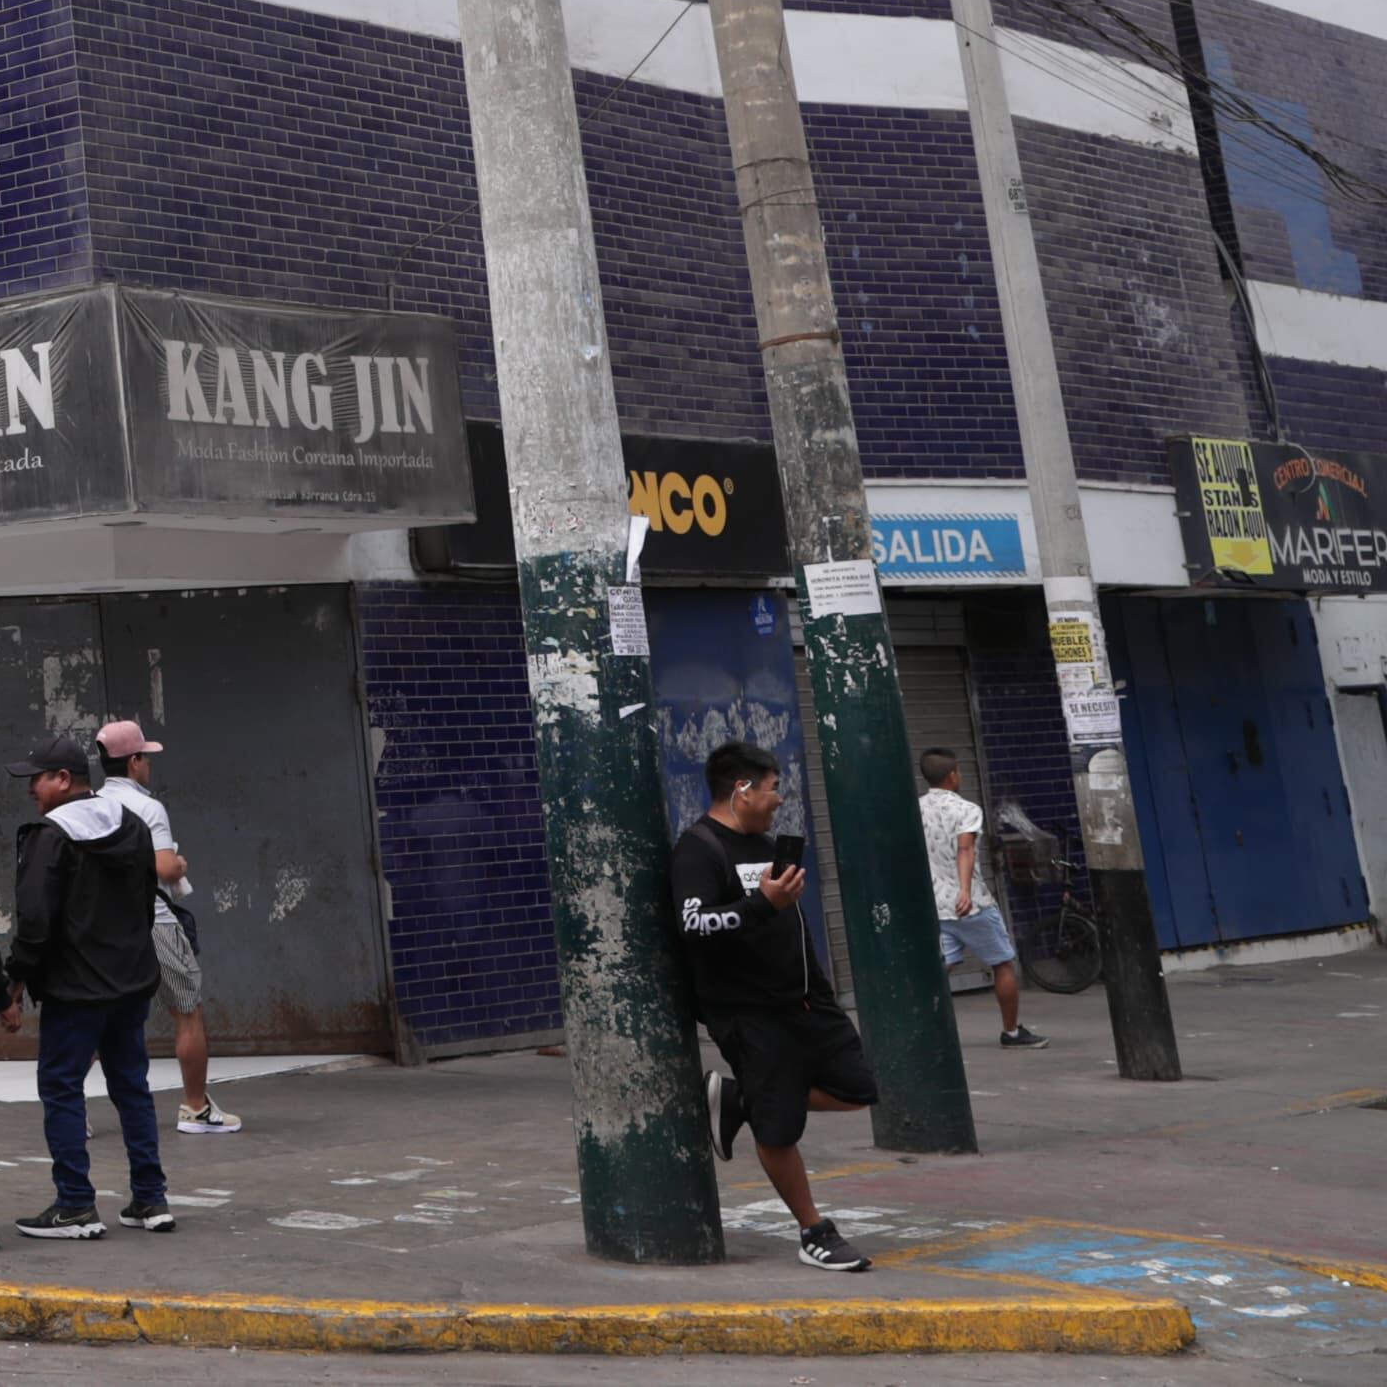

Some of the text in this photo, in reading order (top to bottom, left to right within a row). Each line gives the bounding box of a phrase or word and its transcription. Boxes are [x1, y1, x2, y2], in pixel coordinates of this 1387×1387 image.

[162, 339, 434, 444] KANG JIN
[176, 438, 225, 461] Moda
[292, 448, 356, 468] Coreana
[358, 448, 435, 473] Importada
[1194, 441, 1213, 484] SE
[1273, 457, 1311, 491] CENTRO
[1204, 489, 1260, 509] STANS
[872, 529, 994, 564] SALIDA
[1303, 568, 1372, 586] MODA Y ESTILO
